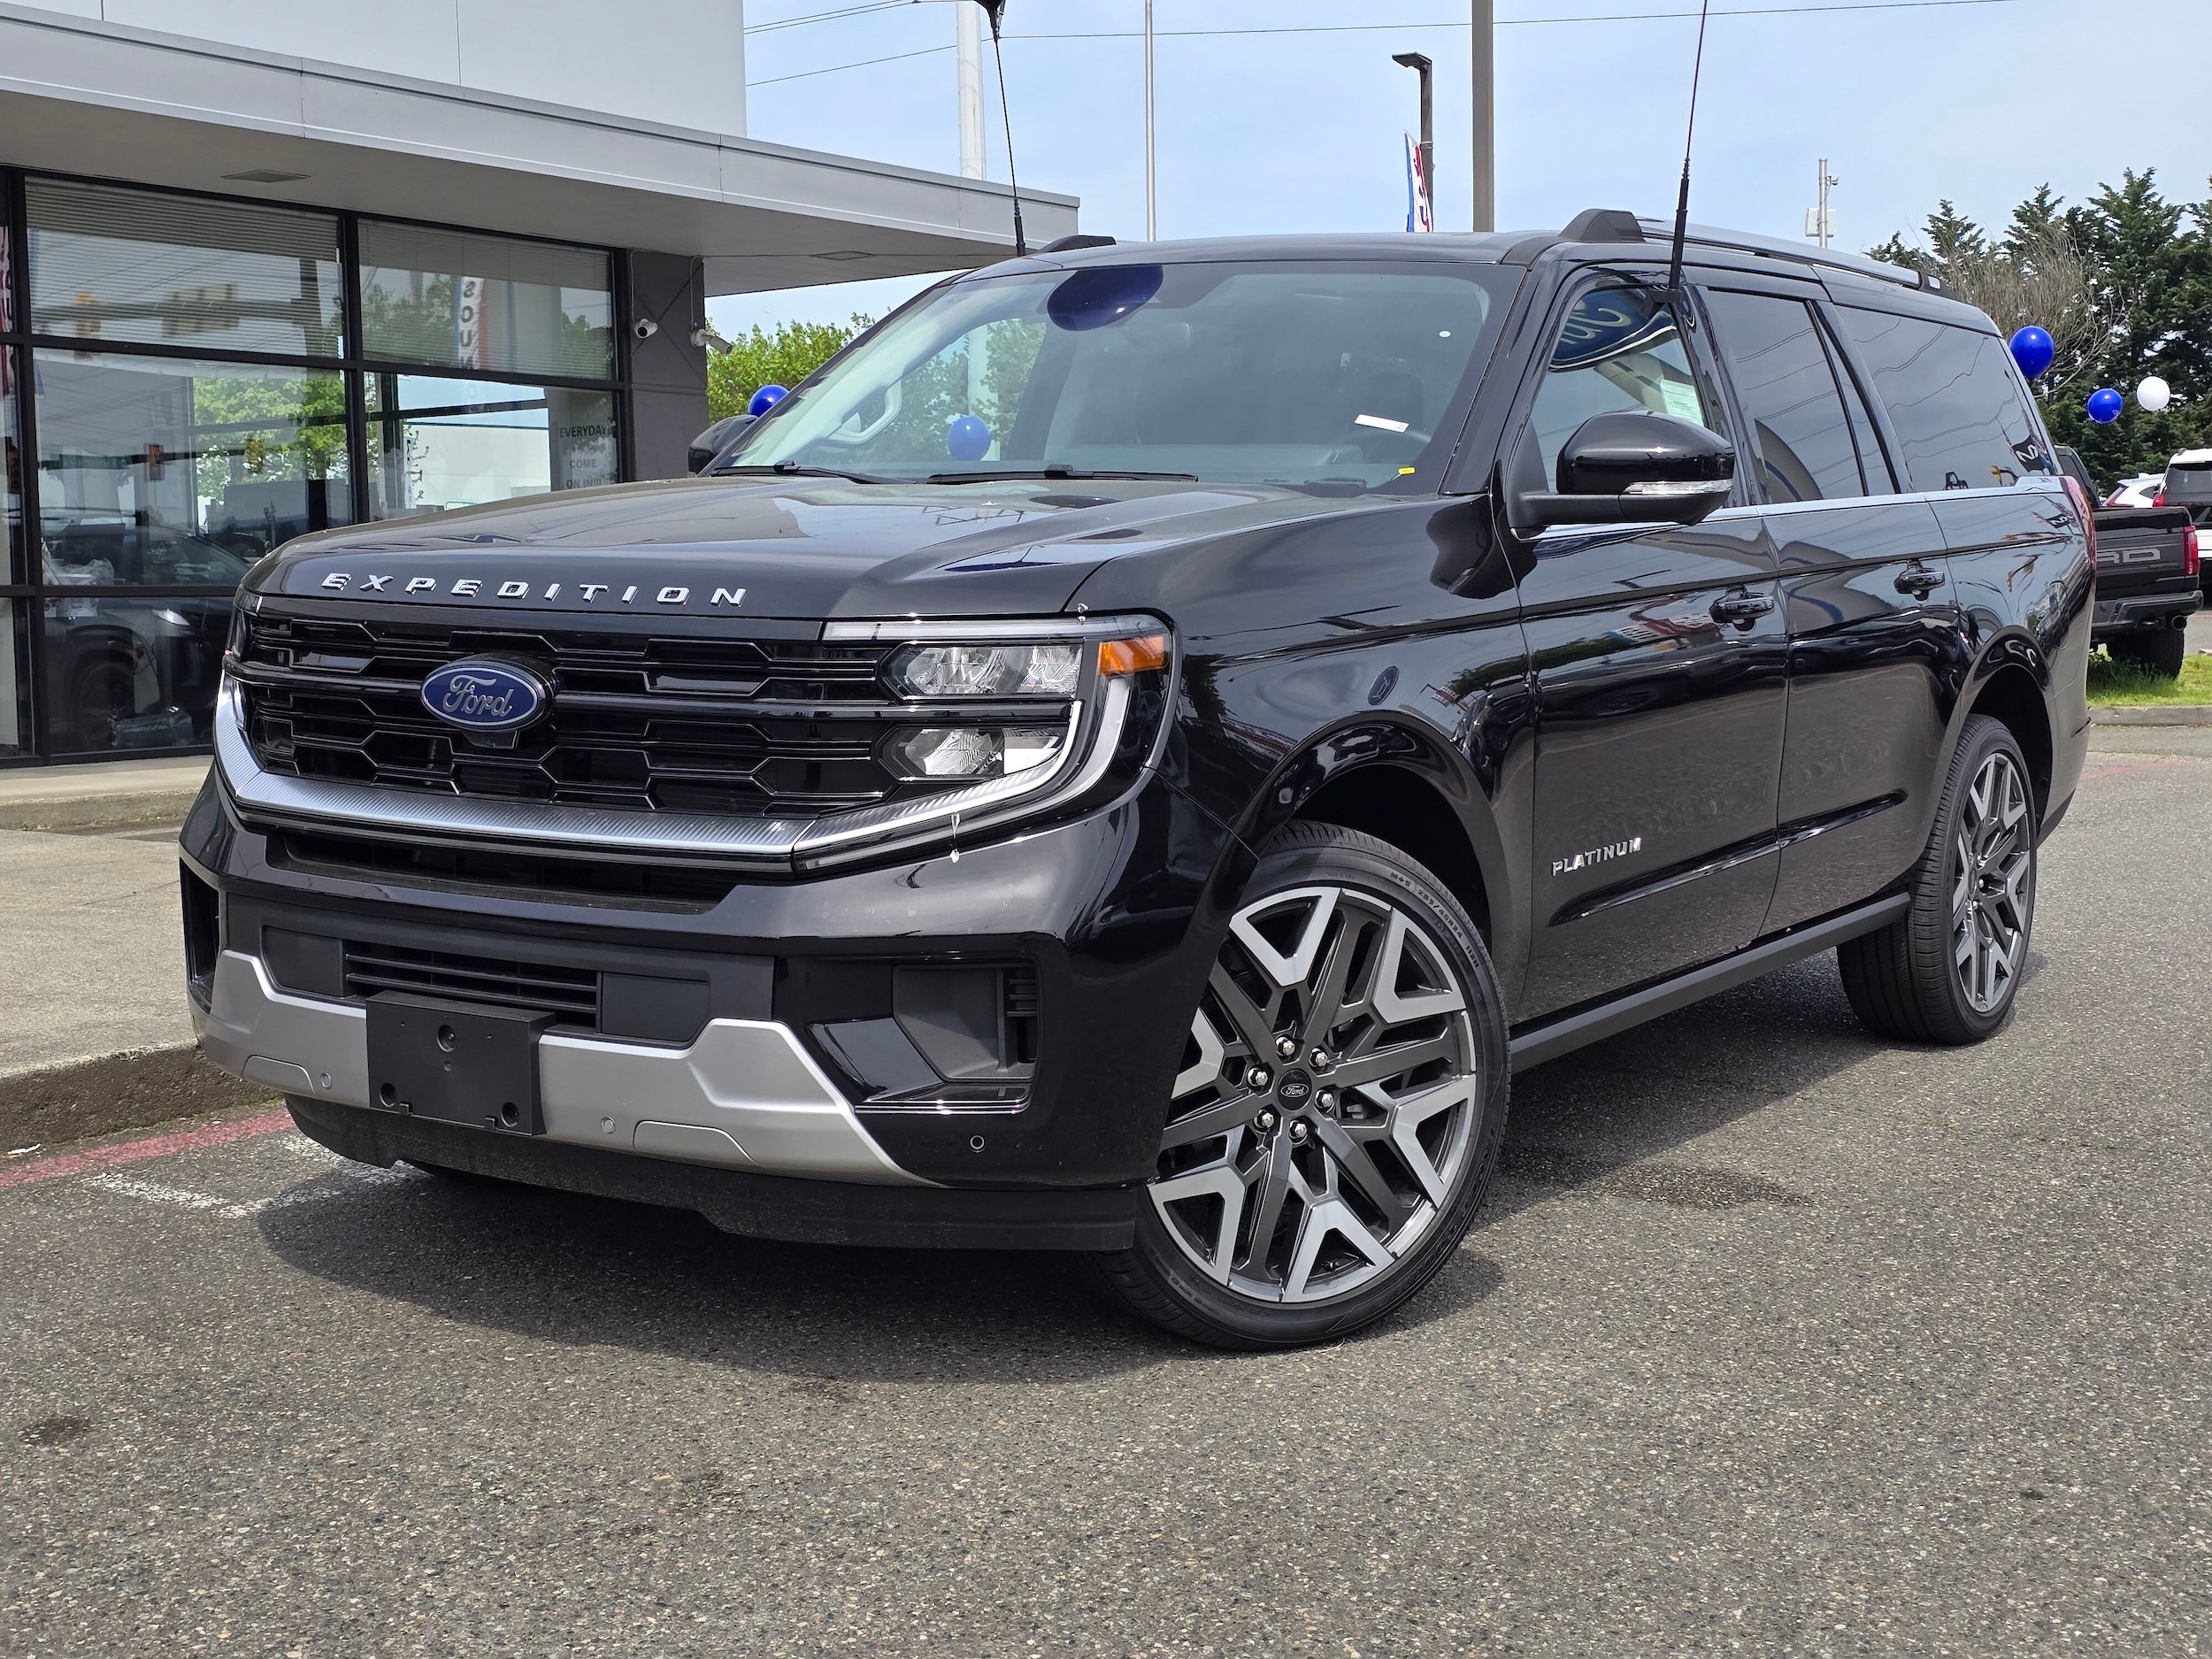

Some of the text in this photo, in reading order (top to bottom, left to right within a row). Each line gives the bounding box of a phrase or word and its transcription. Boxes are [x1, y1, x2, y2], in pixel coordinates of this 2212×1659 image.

[559, 425, 608, 439] EVERYDAY
[570, 458, 597, 469] COME
[566, 479, 580, 489] ON
[320, 572, 748, 608] EXPEDITION
[442, 674, 515, 718] Ford
[1551, 837, 1642, 877] PLATINUM
[1417, 889, 1463, 939] 285/40R24
[1286, 1085, 1305, 1095] Ford
